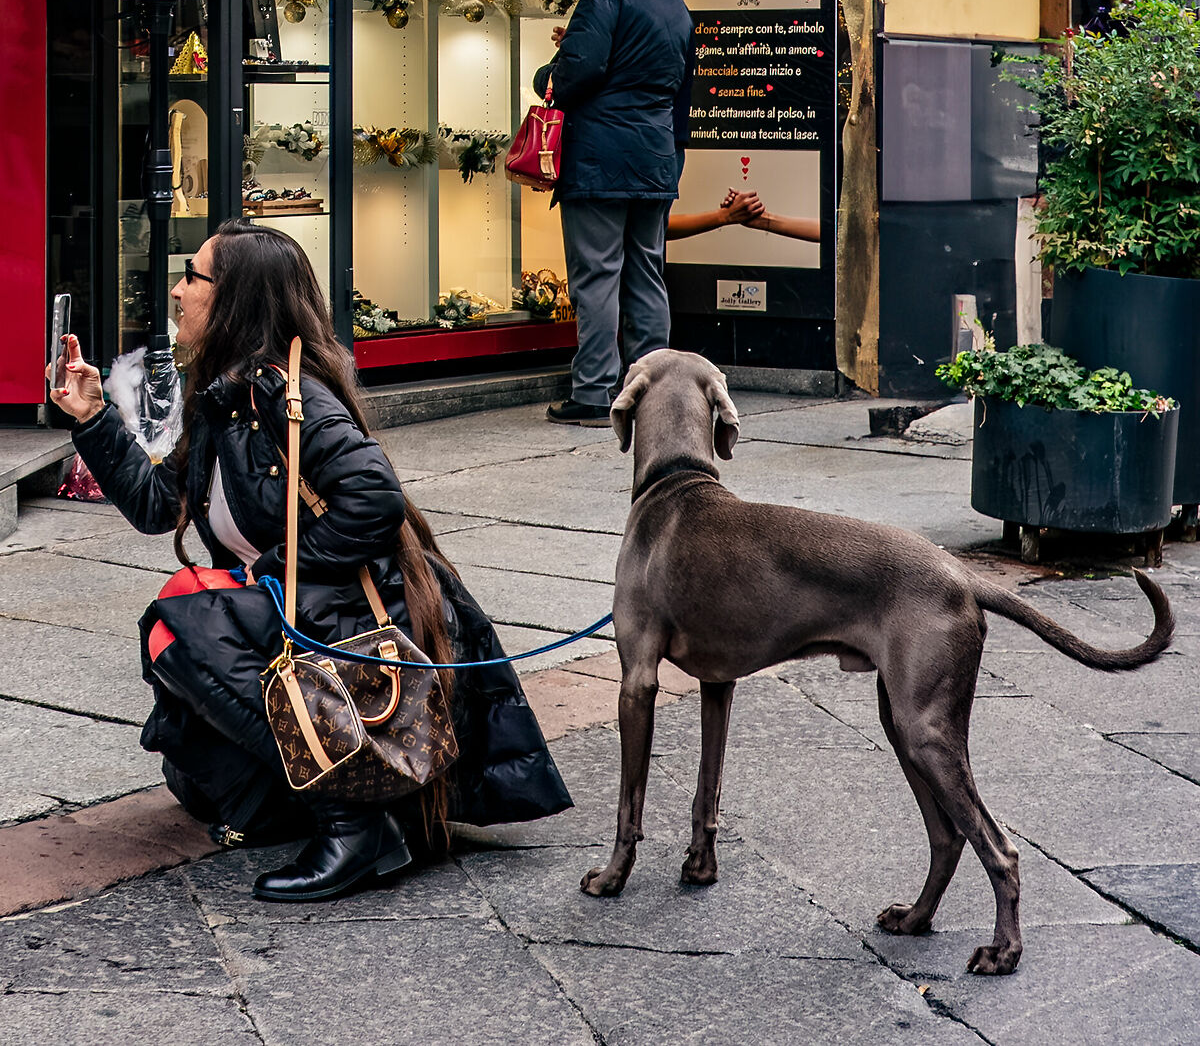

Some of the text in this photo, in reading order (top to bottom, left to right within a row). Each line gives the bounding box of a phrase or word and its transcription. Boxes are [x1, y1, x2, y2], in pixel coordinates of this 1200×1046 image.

[695, 21, 825, 38] d'oro sempre con te, simbolo
[775, 46, 787, 55] un
[788, 46, 817, 55] amore
[698, 64, 739, 76] bracciale
[740, 67, 767, 76] senza
[769, 64, 794, 76] inizio
[795, 67, 801, 76] e
[718, 85, 767, 97] senza fine.
[708, 106, 766, 119] direttamente
[767, 107, 776, 118] al
[777, 106, 805, 122] polso,
[807, 106, 815, 118] in
[691, 127, 819, 140] minuti, con una tecnica laser.
[555, 305, 576, 322] 50%
